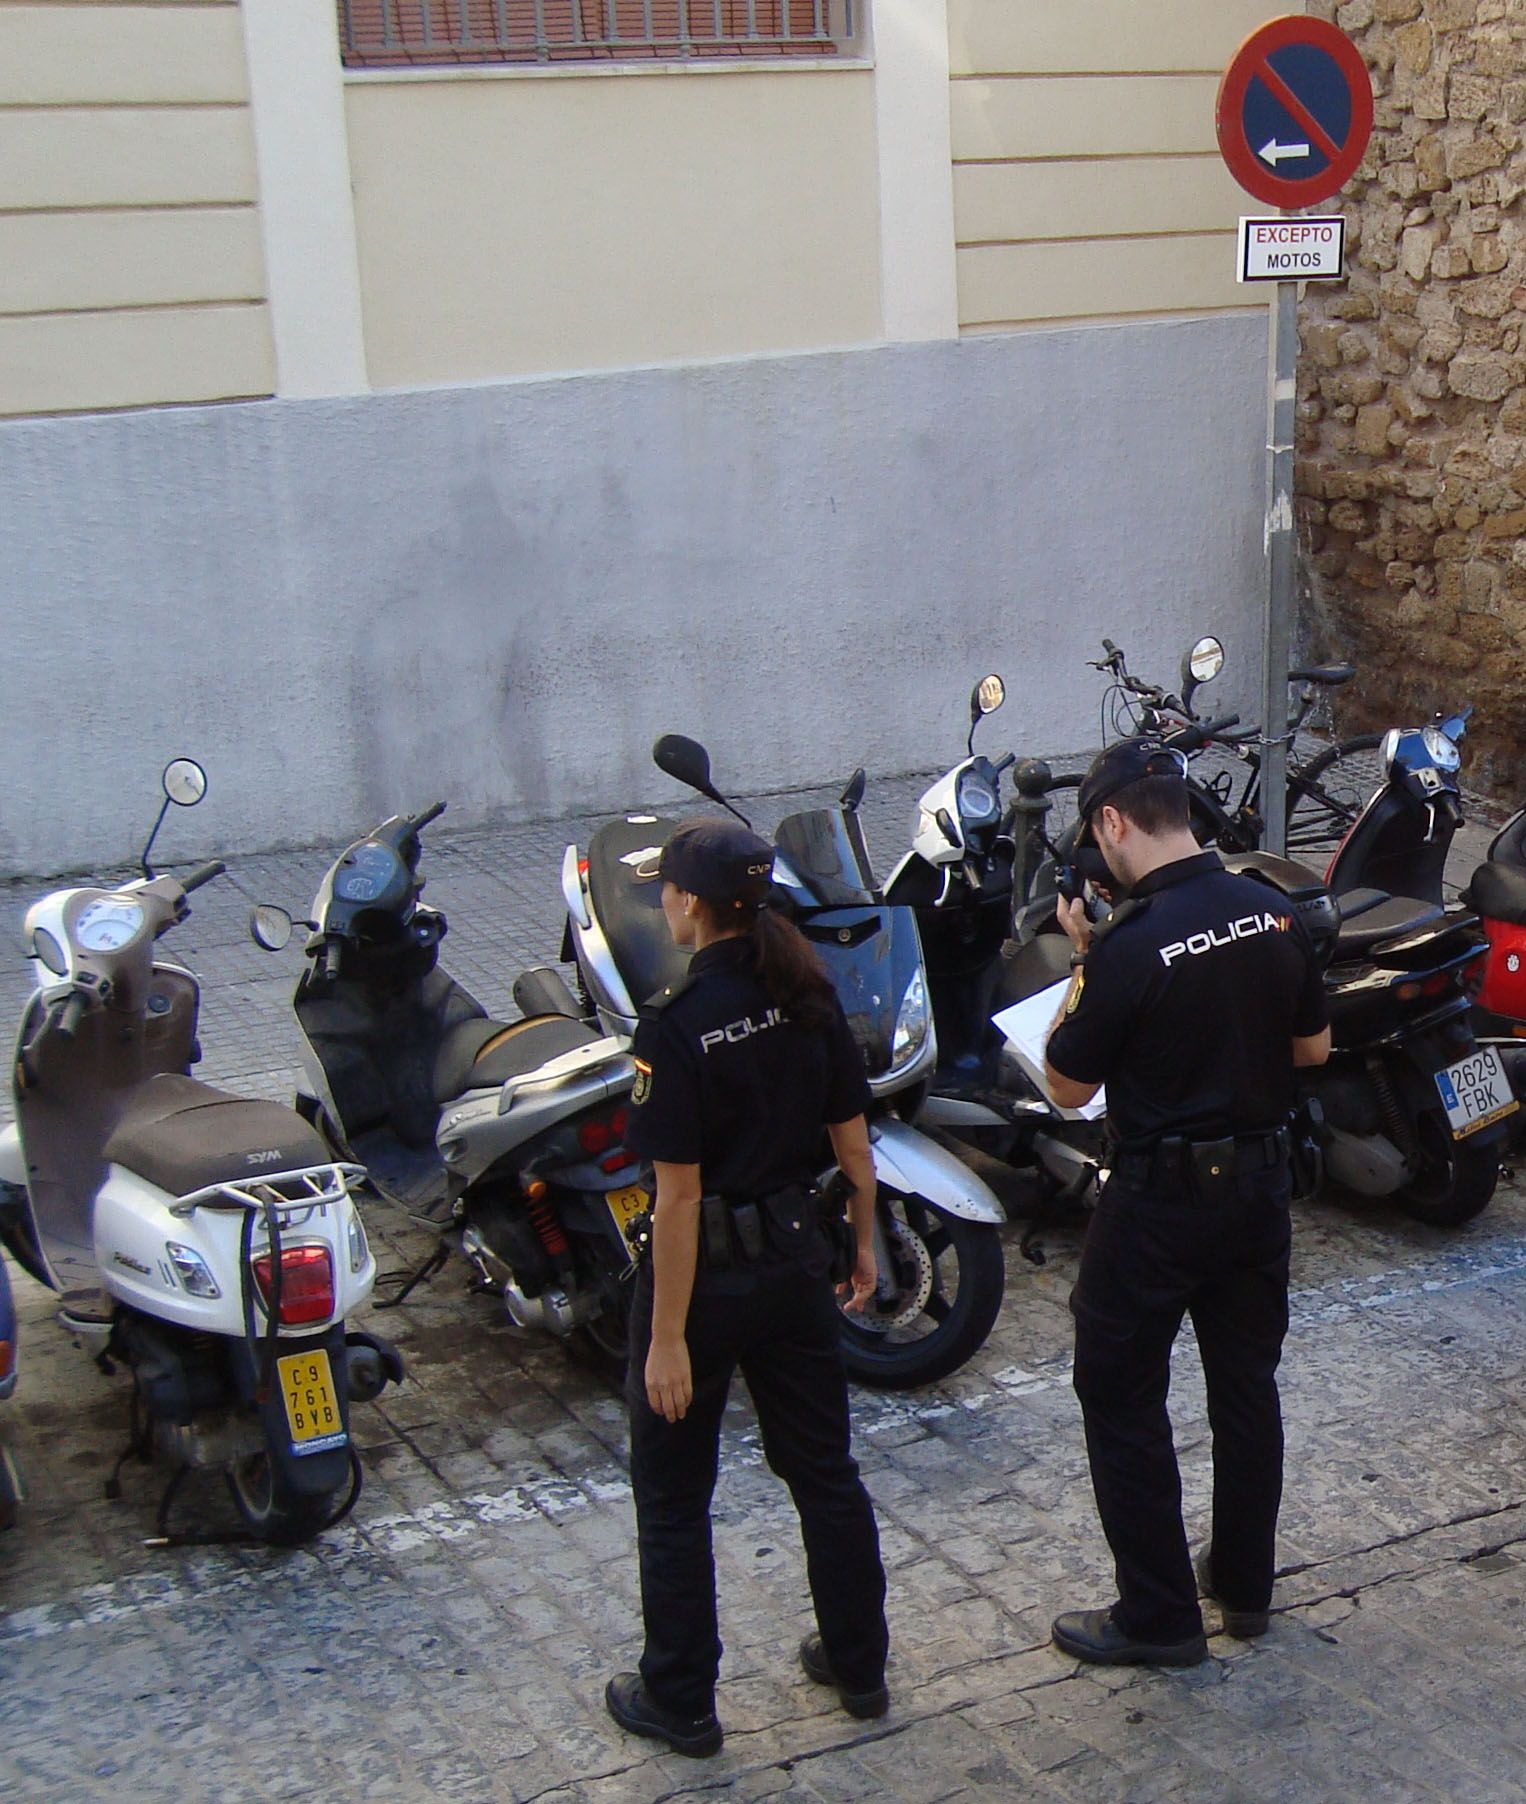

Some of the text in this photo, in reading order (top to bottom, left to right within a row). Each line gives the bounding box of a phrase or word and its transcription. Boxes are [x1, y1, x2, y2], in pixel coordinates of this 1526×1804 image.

[1256, 227, 1333, 243] EXCEPTO
[1267, 252, 1321, 269] MOTOS
[747, 864, 771, 875] CNP
[1159, 912, 1279, 967] POLICIA
[700, 1007, 791, 1054] POLIC
[1451, 1053, 1498, 1094] 2629
[1462, 1081, 1500, 1118] FBK
[247, 1150, 272, 1164] SYM
[290, 1386, 327, 1409] 761
[295, 1406, 333, 1430] BVB
